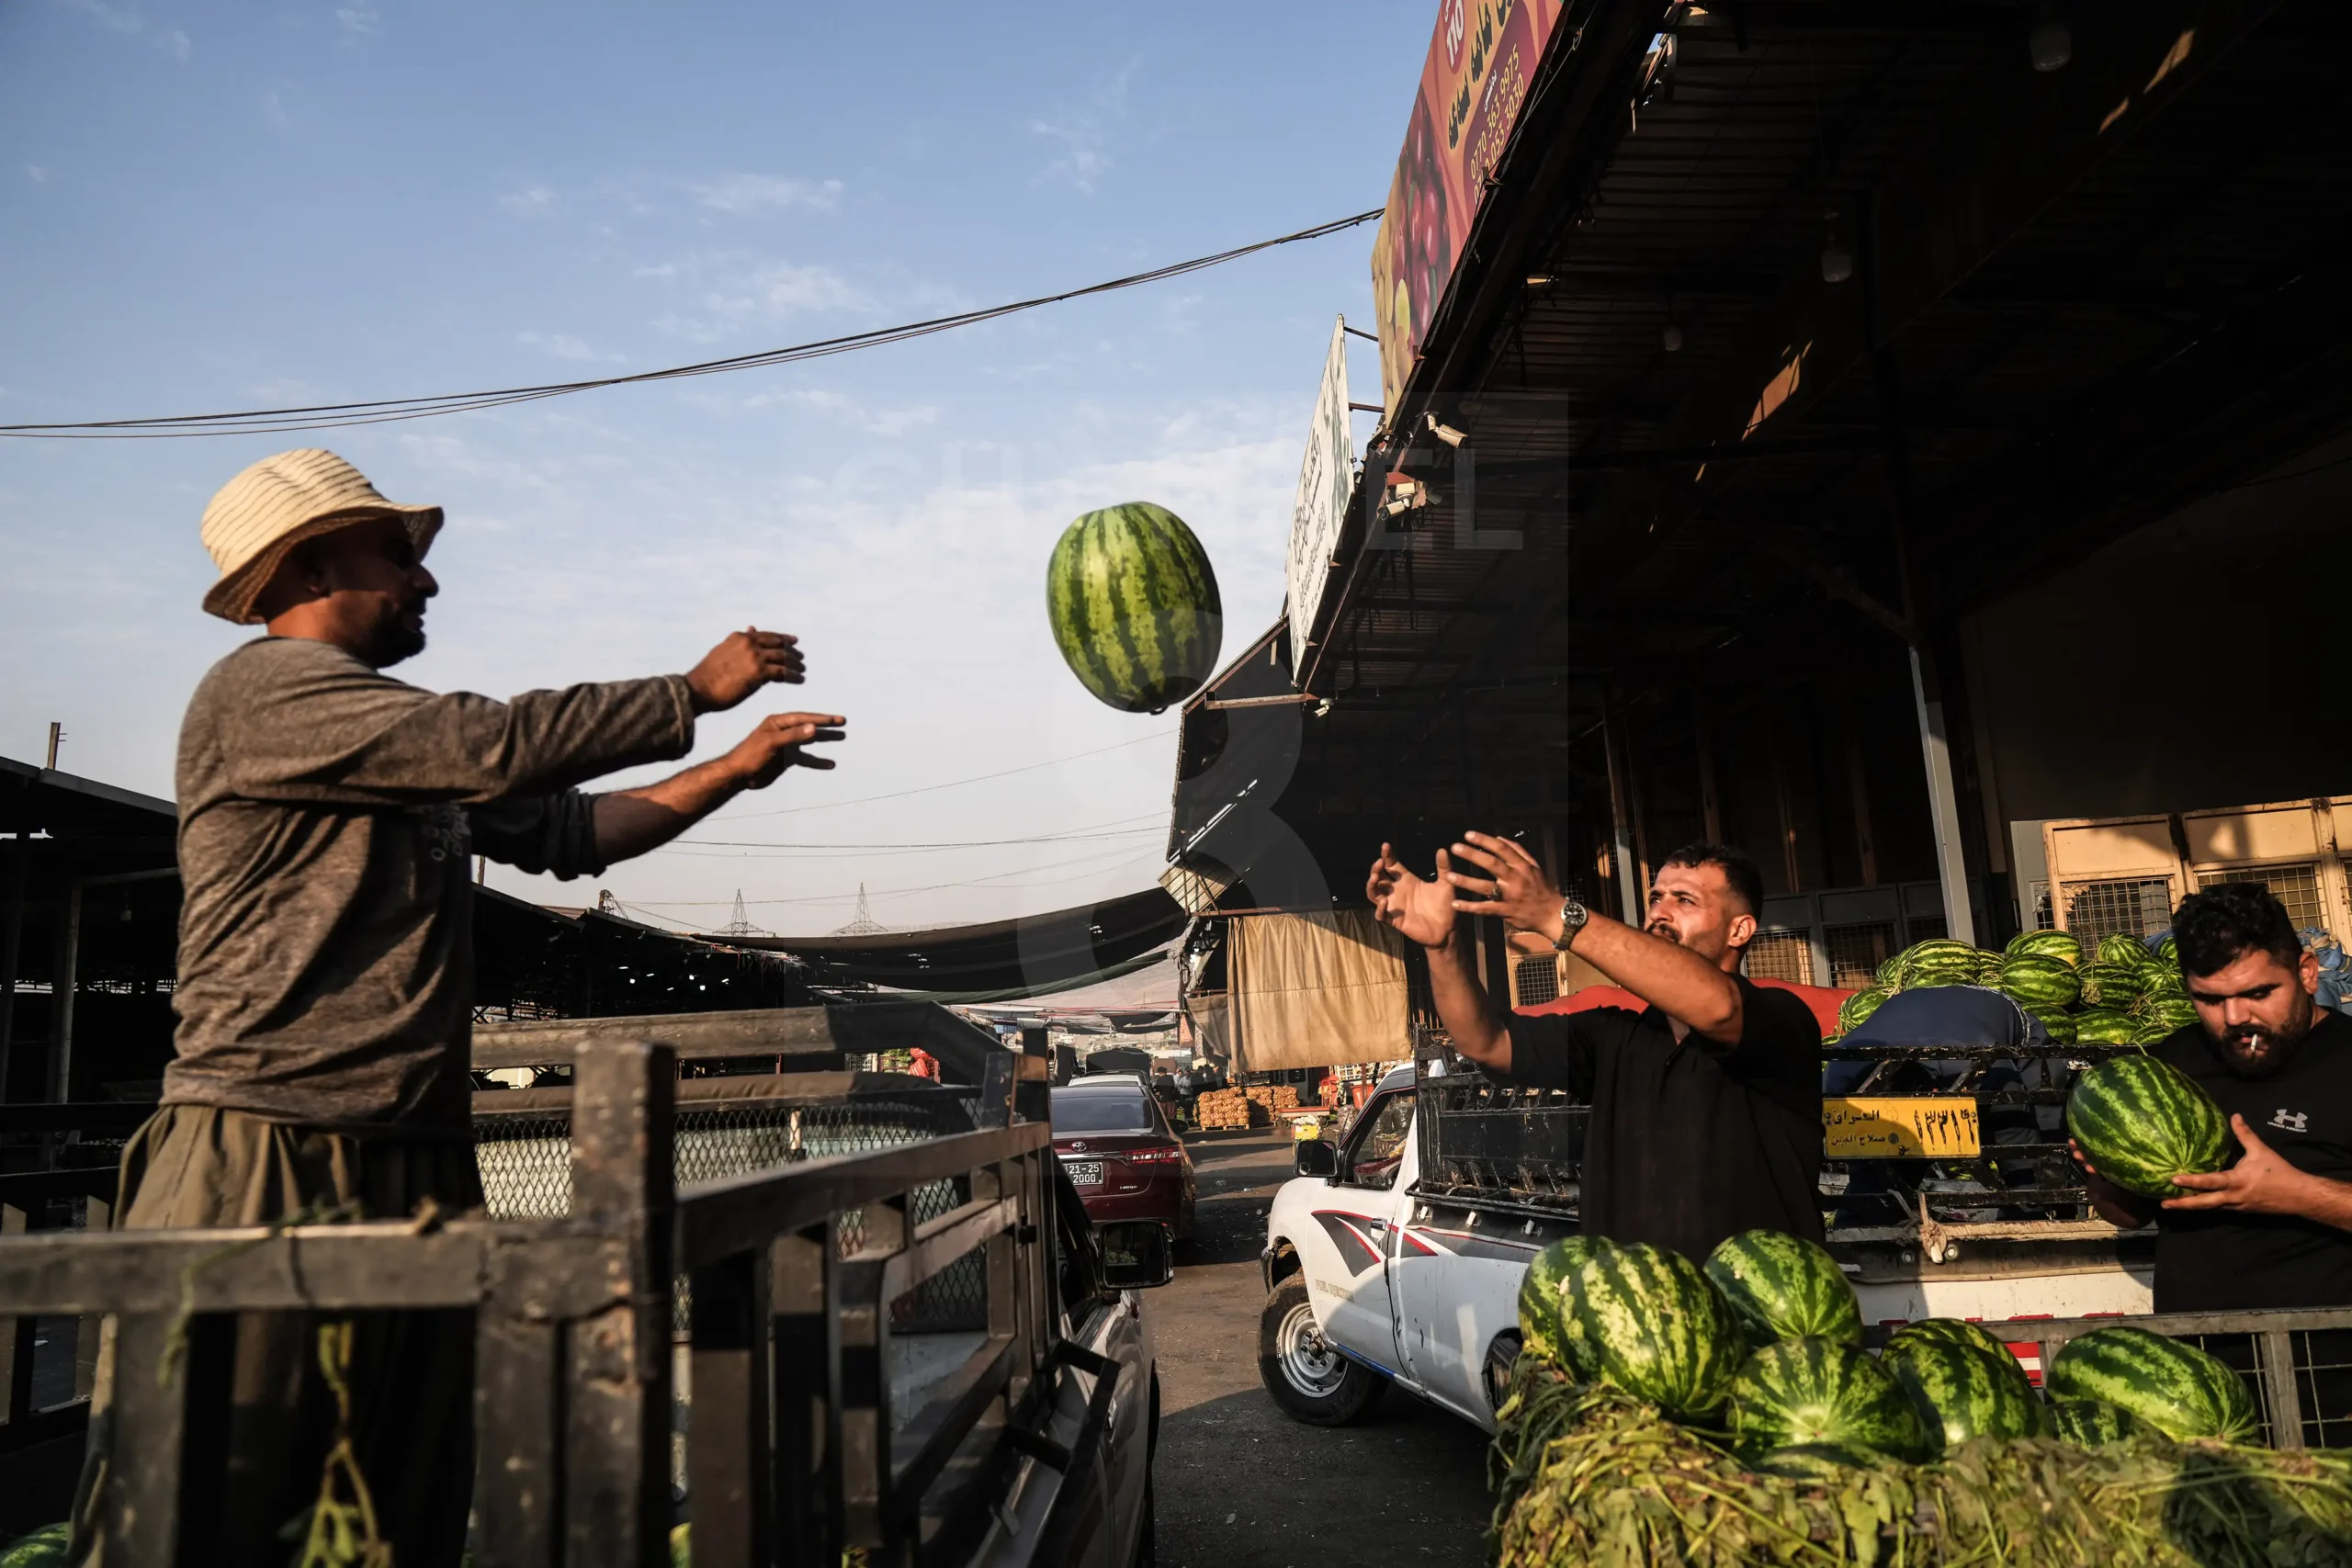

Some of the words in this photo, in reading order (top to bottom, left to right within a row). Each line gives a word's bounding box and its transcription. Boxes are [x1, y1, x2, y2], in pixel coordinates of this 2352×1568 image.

[1446, 0, 1464, 68] 110
[1470, 130, 1487, 180] 0770
[1487, 93, 1500, 140] 363
[1499, 42, 1520, 102] 9975
[1474, 157, 1490, 205] 070
[1490, 119, 1505, 164] 053
[1504, 72, 1524, 130] 3030
[1832, 1109, 1880, 1125] العراق
[1859, 1133, 1885, 1145] صلاح
[1069, 1164, 1100, 1174] 21-25
[1072, 1174, 1096, 1183] 2000
